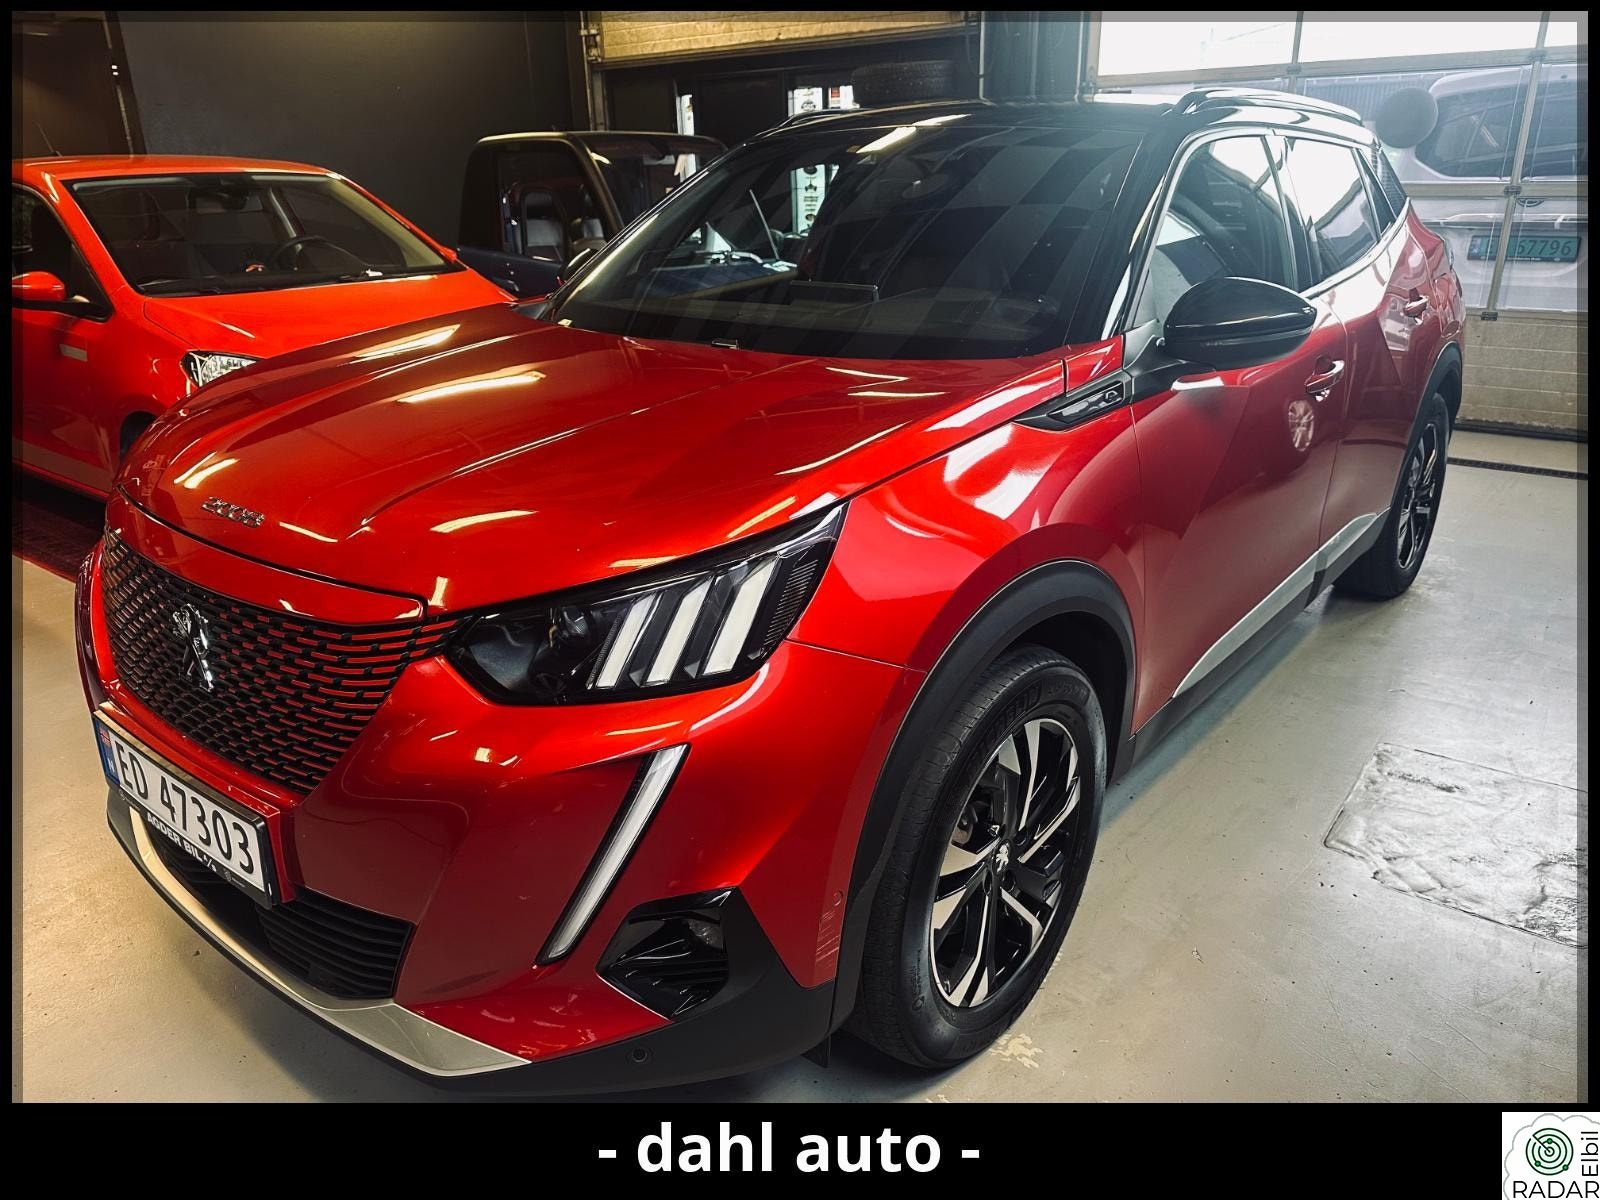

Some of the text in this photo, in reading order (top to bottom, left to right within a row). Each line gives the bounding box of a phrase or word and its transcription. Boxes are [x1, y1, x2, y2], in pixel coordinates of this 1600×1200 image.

[202, 496, 265, 528] 2008
[115, 740, 255, 875] ED 47303
[183, 839, 203, 862] BIL
